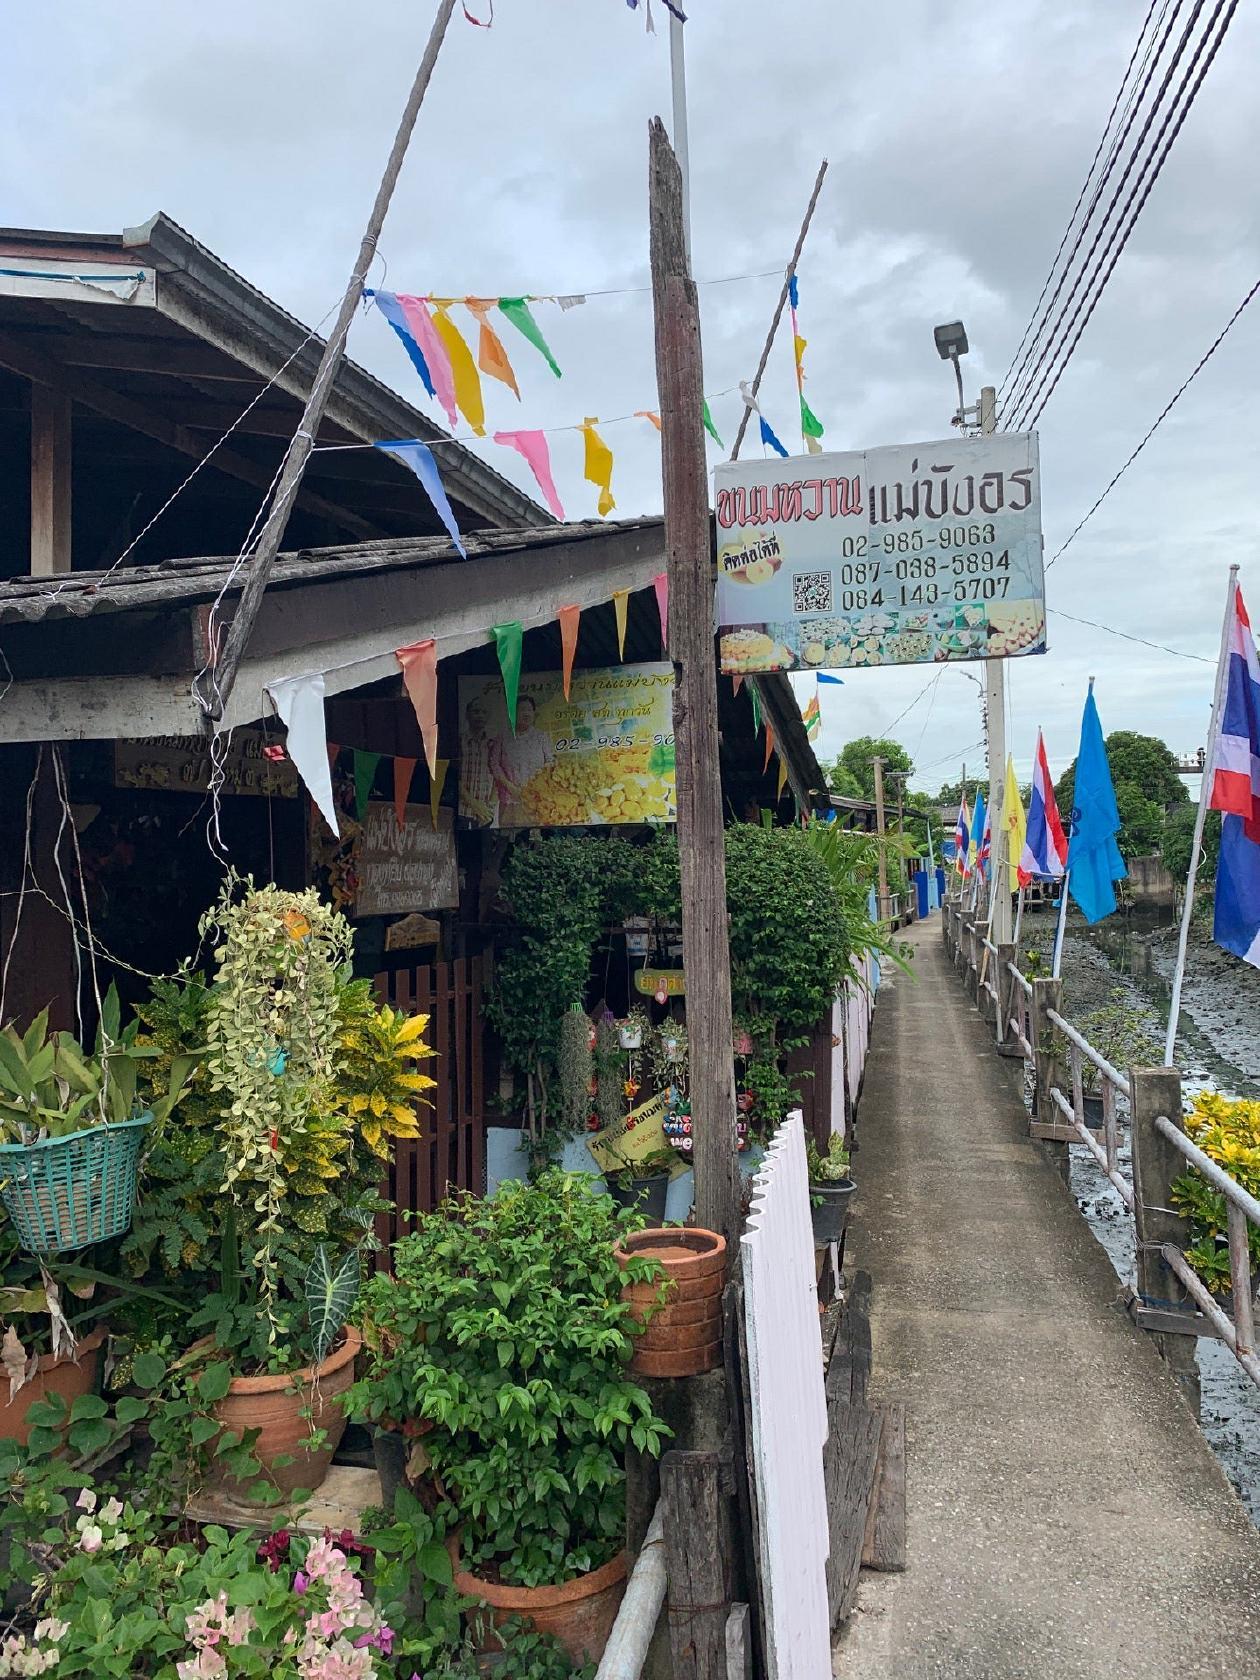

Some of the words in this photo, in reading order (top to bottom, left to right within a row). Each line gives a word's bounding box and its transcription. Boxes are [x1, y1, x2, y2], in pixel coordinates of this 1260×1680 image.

[716, 475, 864, 529] ขนมหวาน
[868, 458, 1034, 526] แม่บังอร
[722, 530, 780, 571] ติดต่อได้ที่
[842, 523, 996, 558] 02-985-9063
[841, 549, 1012, 586] 087-038-5894
[842, 576, 1011, 611] 084-143-5707
